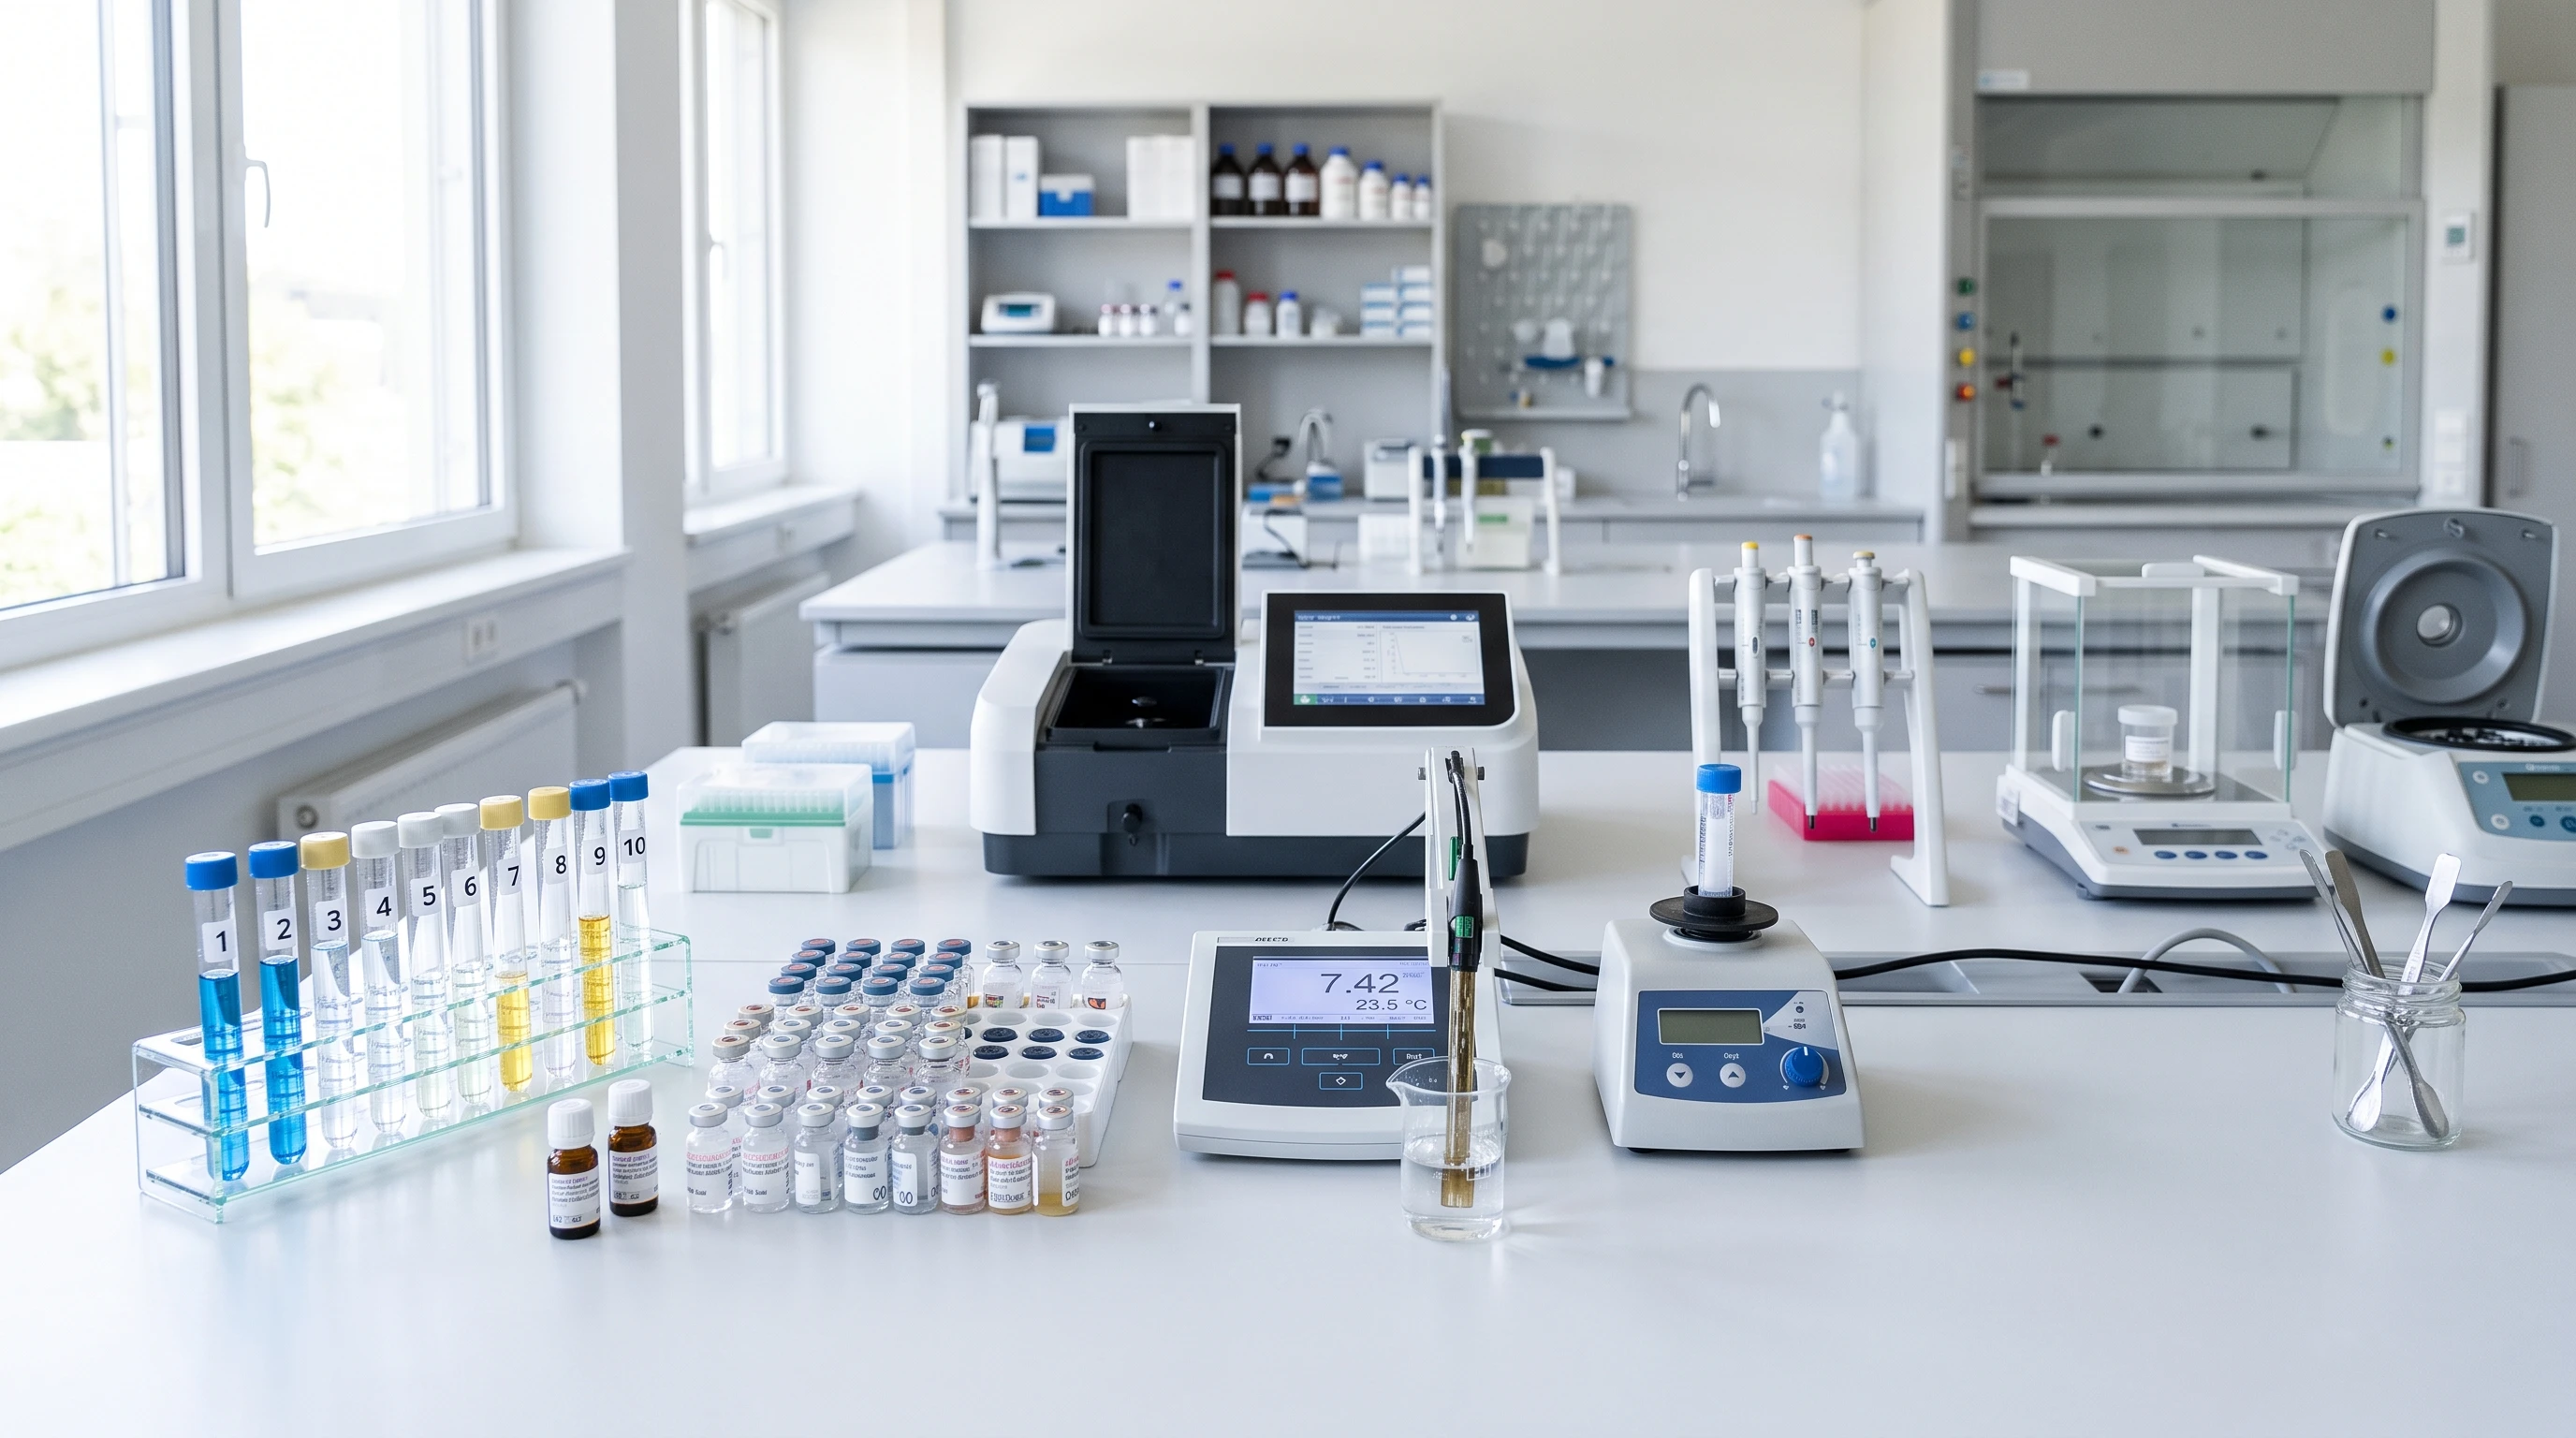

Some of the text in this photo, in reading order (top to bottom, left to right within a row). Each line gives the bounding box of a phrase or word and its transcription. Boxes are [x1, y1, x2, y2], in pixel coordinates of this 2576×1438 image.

[593, 846, 606, 866] 9
[623, 836, 646, 856] 10
[555, 855, 567, 874] 8
[464, 876, 477, 897] 6
[507, 865, 520, 887] 7
[422, 885, 436, 906] 5
[376, 896, 392, 917] 4
[277, 918, 292, 941] 2
[327, 910, 342, 932] 3
[215, 931, 227, 952] 1
[1321, 973, 1399, 993] 7.42
[1355, 999, 1427, 1011] 23.5 °C
